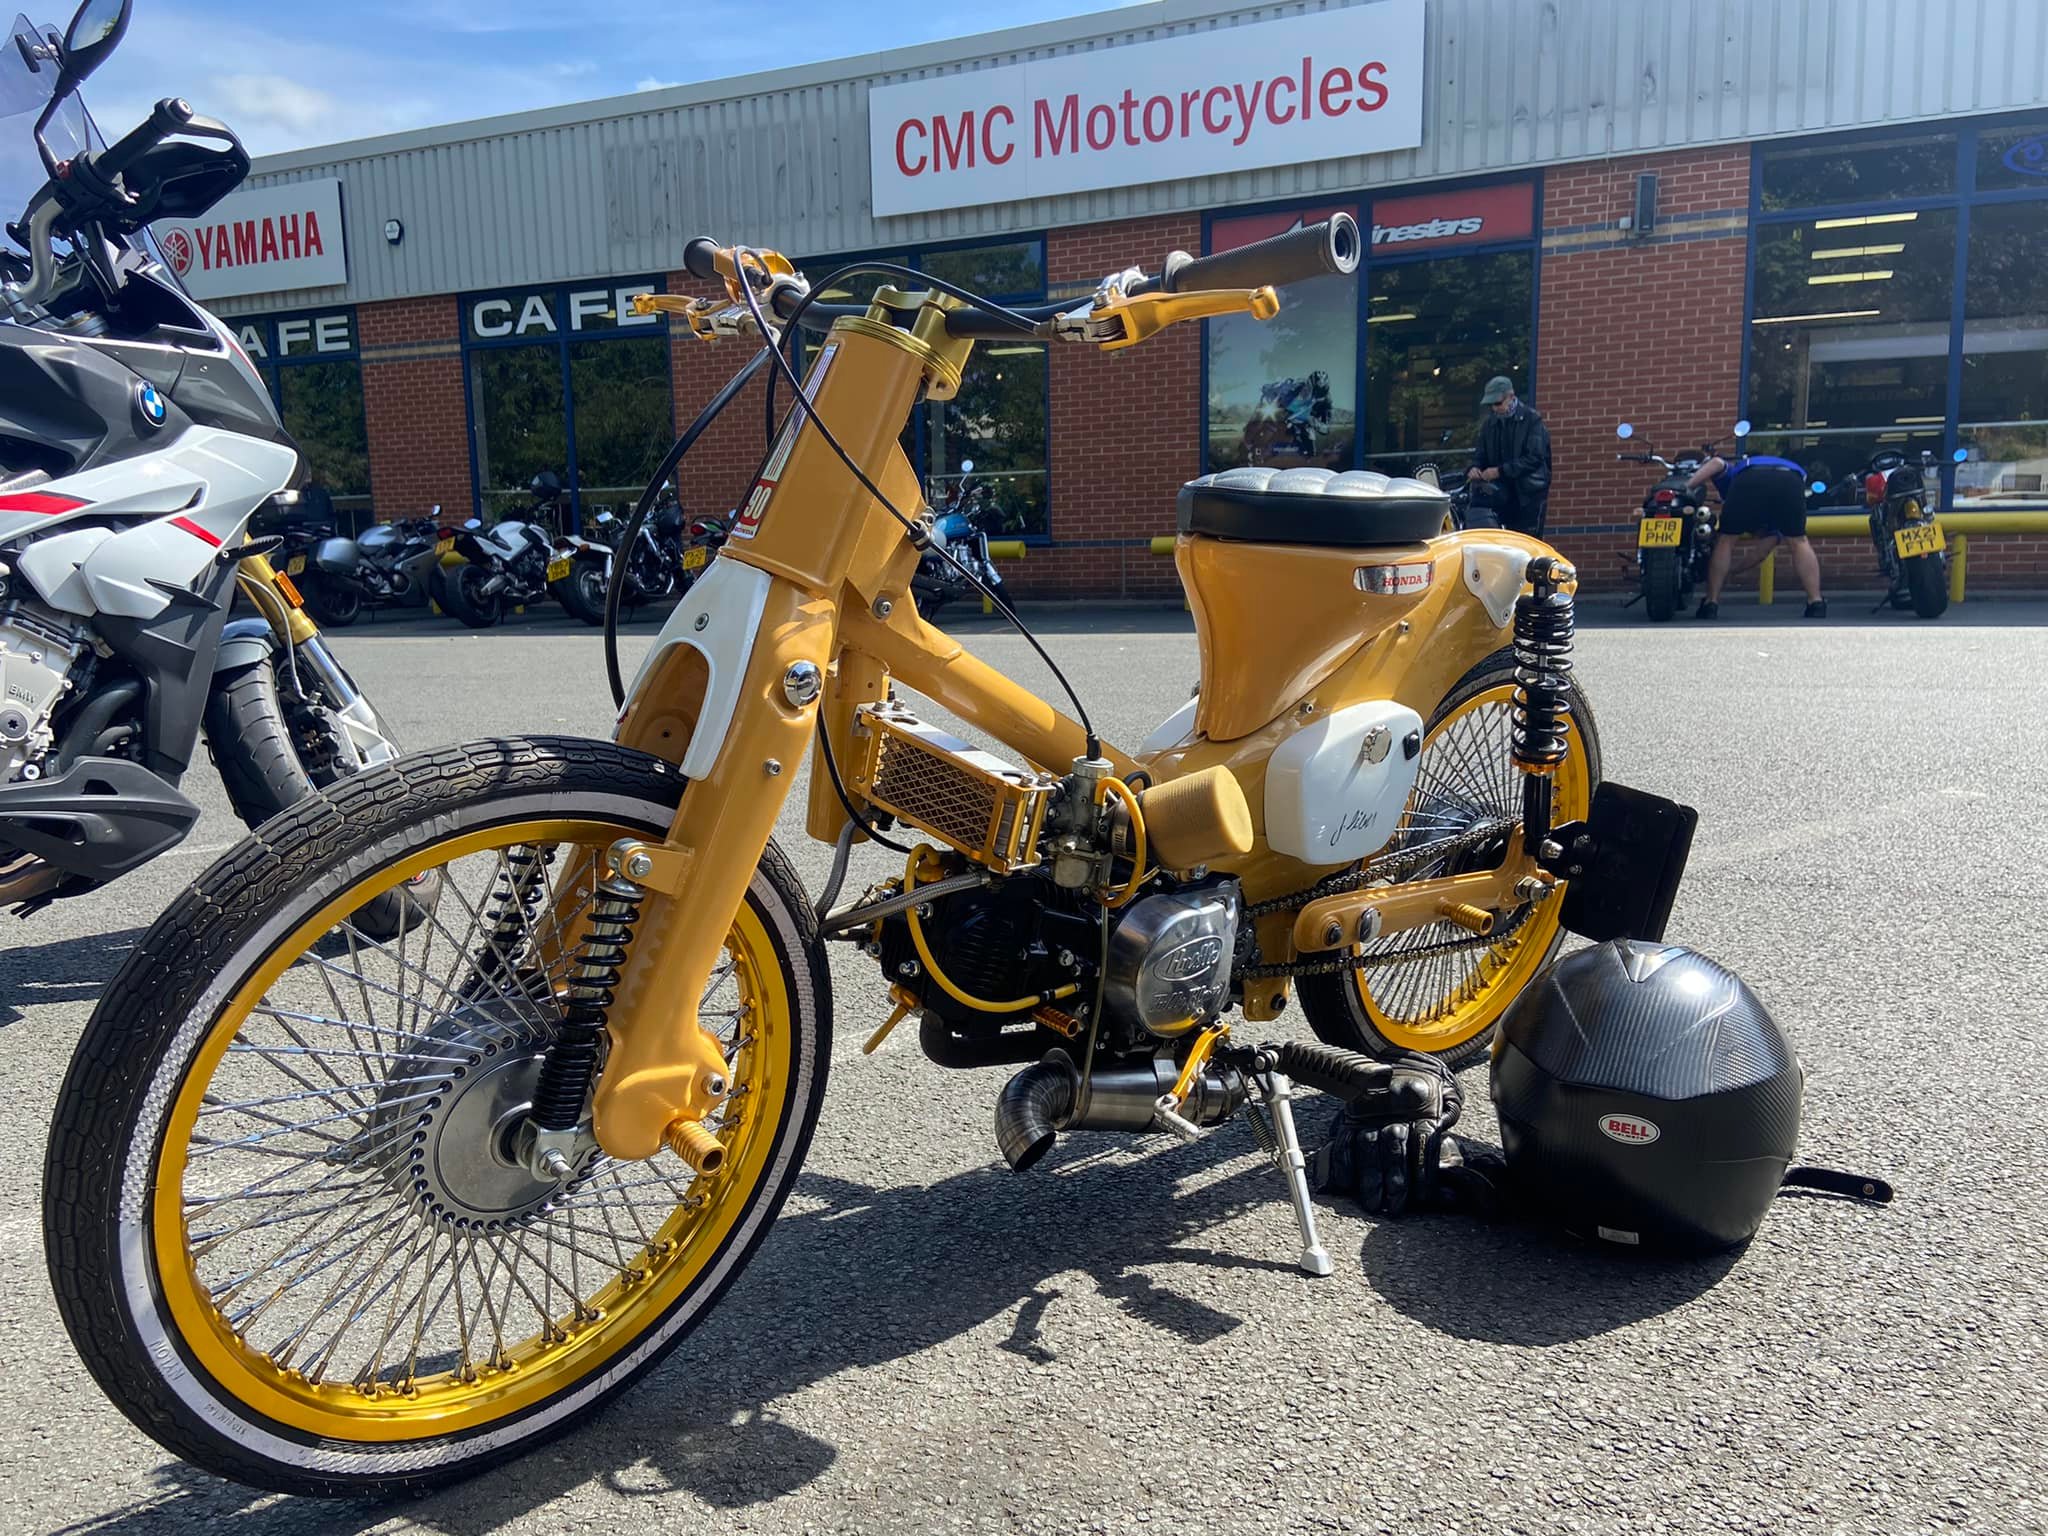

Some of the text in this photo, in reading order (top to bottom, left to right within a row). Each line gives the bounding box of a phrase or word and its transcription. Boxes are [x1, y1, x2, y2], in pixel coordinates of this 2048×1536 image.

[895, 56, 1389, 177] CMC Motorcycles
[194, 210, 324, 271] YAMAHA
[1371, 216, 1483, 245] inestars
[473, 285, 657, 338] CAFE
[238, 315, 350, 358] AFE
[743, 484, 773, 520] 90
[1645, 520, 1677, 532] LF18
[1901, 525, 1936, 542] MX21
[1645, 532, 1674, 543] PHK
[1905, 539, 1934, 553] FTT
[1382, 575, 1423, 587] HONDA
[8, 683, 35, 704] BMW
[1608, 1119, 1649, 1137] BELL
